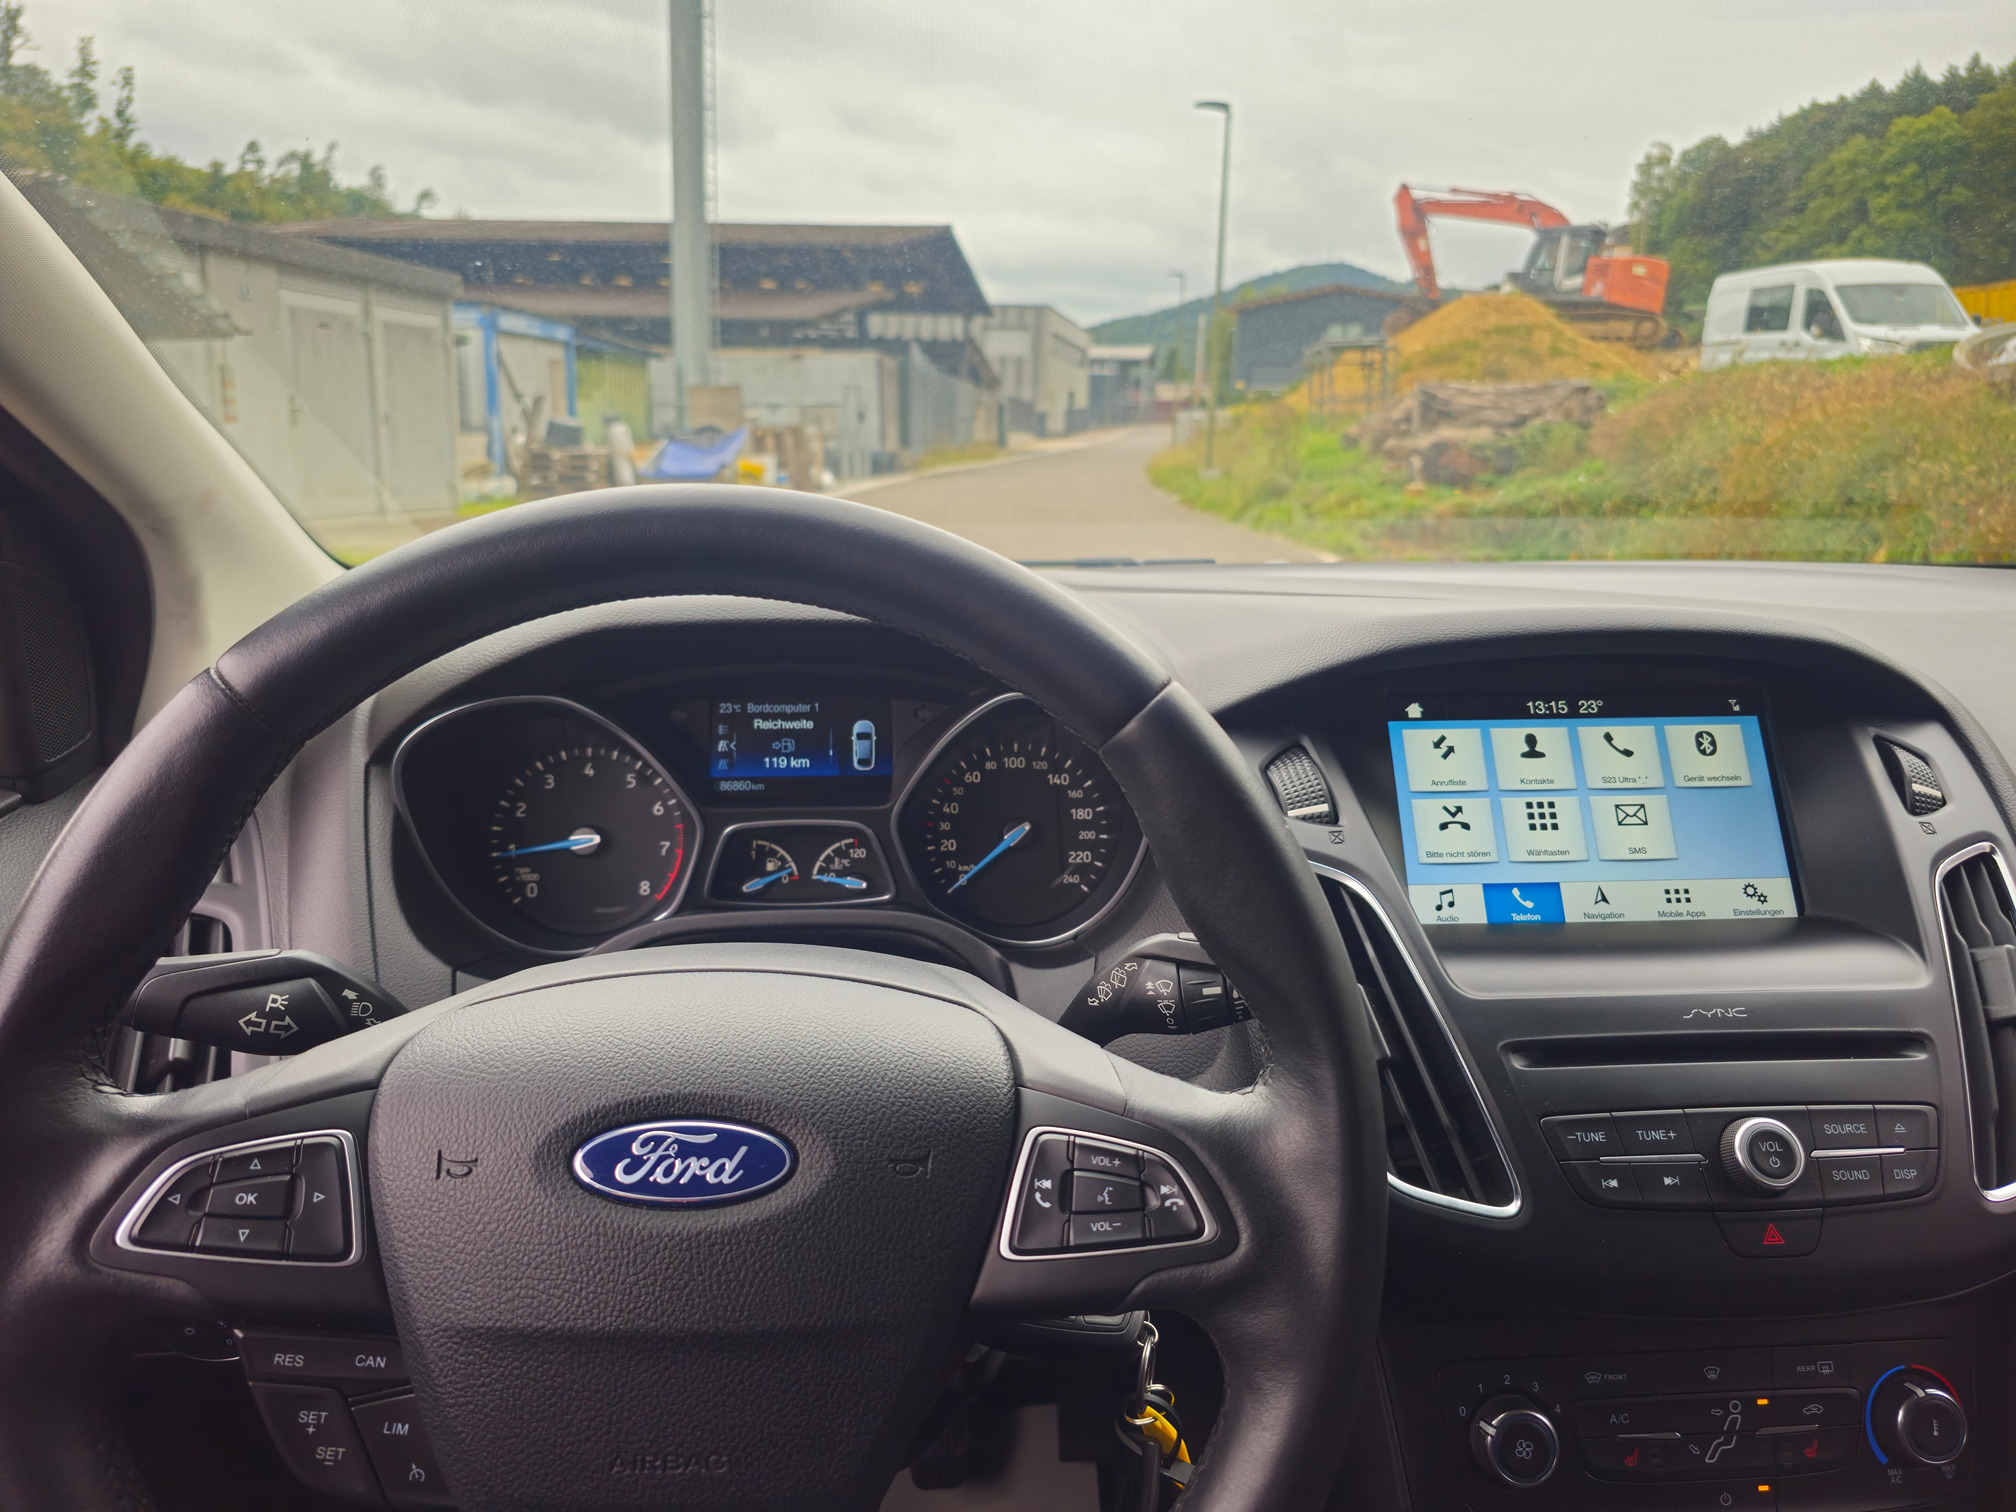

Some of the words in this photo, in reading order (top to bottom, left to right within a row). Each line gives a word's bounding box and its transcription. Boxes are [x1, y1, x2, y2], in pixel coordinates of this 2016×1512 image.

[747, 703, 811, 715] Bordcomputer
[814, 703, 819, 712] 1
[1526, 700, 1569, 714] 13:15
[1578, 700, 1603, 714] 23°
[753, 719, 814, 730] Reichweite
[764, 757, 787, 768] 119
[790, 756, 810, 768] km
[985, 761, 997, 770] 80
[1003, 757, 1026, 769] 100
[1032, 761, 1048, 770] 120
[584, 763, 595, 777] 4
[544, 774, 555, 789] 3
[626, 774, 636, 788] 5
[964, 771, 981, 783] 60
[1047, 774, 1070, 785] 140
[1601, 776, 1617, 784] S23
[1683, 774, 1705, 782] Gerät
[1706, 774, 1742, 782] wechseln
[1430, 779, 1467, 787] Anrufliste
[952, 787, 964, 796] 50
[1067, 790, 1083, 799] 160
[515, 802, 526, 817] 2
[653, 801, 664, 816] 6
[942, 802, 959, 814] 40
[1070, 808, 1093, 820] 180
[939, 822, 951, 831] 30
[1078, 831, 1096, 840] 200
[659, 841, 671, 856] 7
[940, 839, 957, 851] 20
[848, 848, 867, 858] 120
[1446, 850, 1465, 858] nicht
[1468, 850, 1491, 858] stören
[1526, 849, 1570, 857] Wähltasten
[1628, 847, 1647, 855] SMS
[1068, 851, 1092, 863] 220
[946, 860, 956, 869] 10
[782, 874, 789, 884] 0
[1062, 875, 1080, 884] 240
[526, 882, 538, 898] 0
[639, 880, 650, 896] 8
[1510, 913, 1541, 921] Telefon
[1583, 911, 1625, 920] Navigation
[1657, 910, 1684, 918] Mobile
[1685, 910, 1706, 919] Apps
[1733, 908, 1784, 917] Einstellungen
[1683, 1008, 1748, 1018] SYNC
[1824, 1123, 1868, 1134] SOURCE
[1636, 1130, 1677, 1141] TUNE+
[1759, 1141, 1783, 1152] VOL
[614, 1130, 749, 1185] Ford
[1090, 1155, 1122, 1167] VOL+
[1832, 1170, 1870, 1181] SOUND
[1893, 1169, 1918, 1179] DISP
[235, 1192, 259, 1205] OK
[273, 1353, 305, 1367] RES
[355, 1354, 387, 1368] CAN
[1504, 1375, 1511, 1385] 2
[1603, 1373, 1627, 1381] FRONT
[1478, 1384, 1483, 1393] 1
[1532, 1382, 1540, 1392] 3
[1459, 1406, 1467, 1417] 0
[1554, 1404, 1561, 1413] 4
[298, 1410, 329, 1424] SET
[1609, 1413, 1630, 1424] A/C
[383, 1421, 409, 1436] LIM
[315, 1447, 346, 1461] SET
[610, 1455, 728, 1474] AIRBAG
